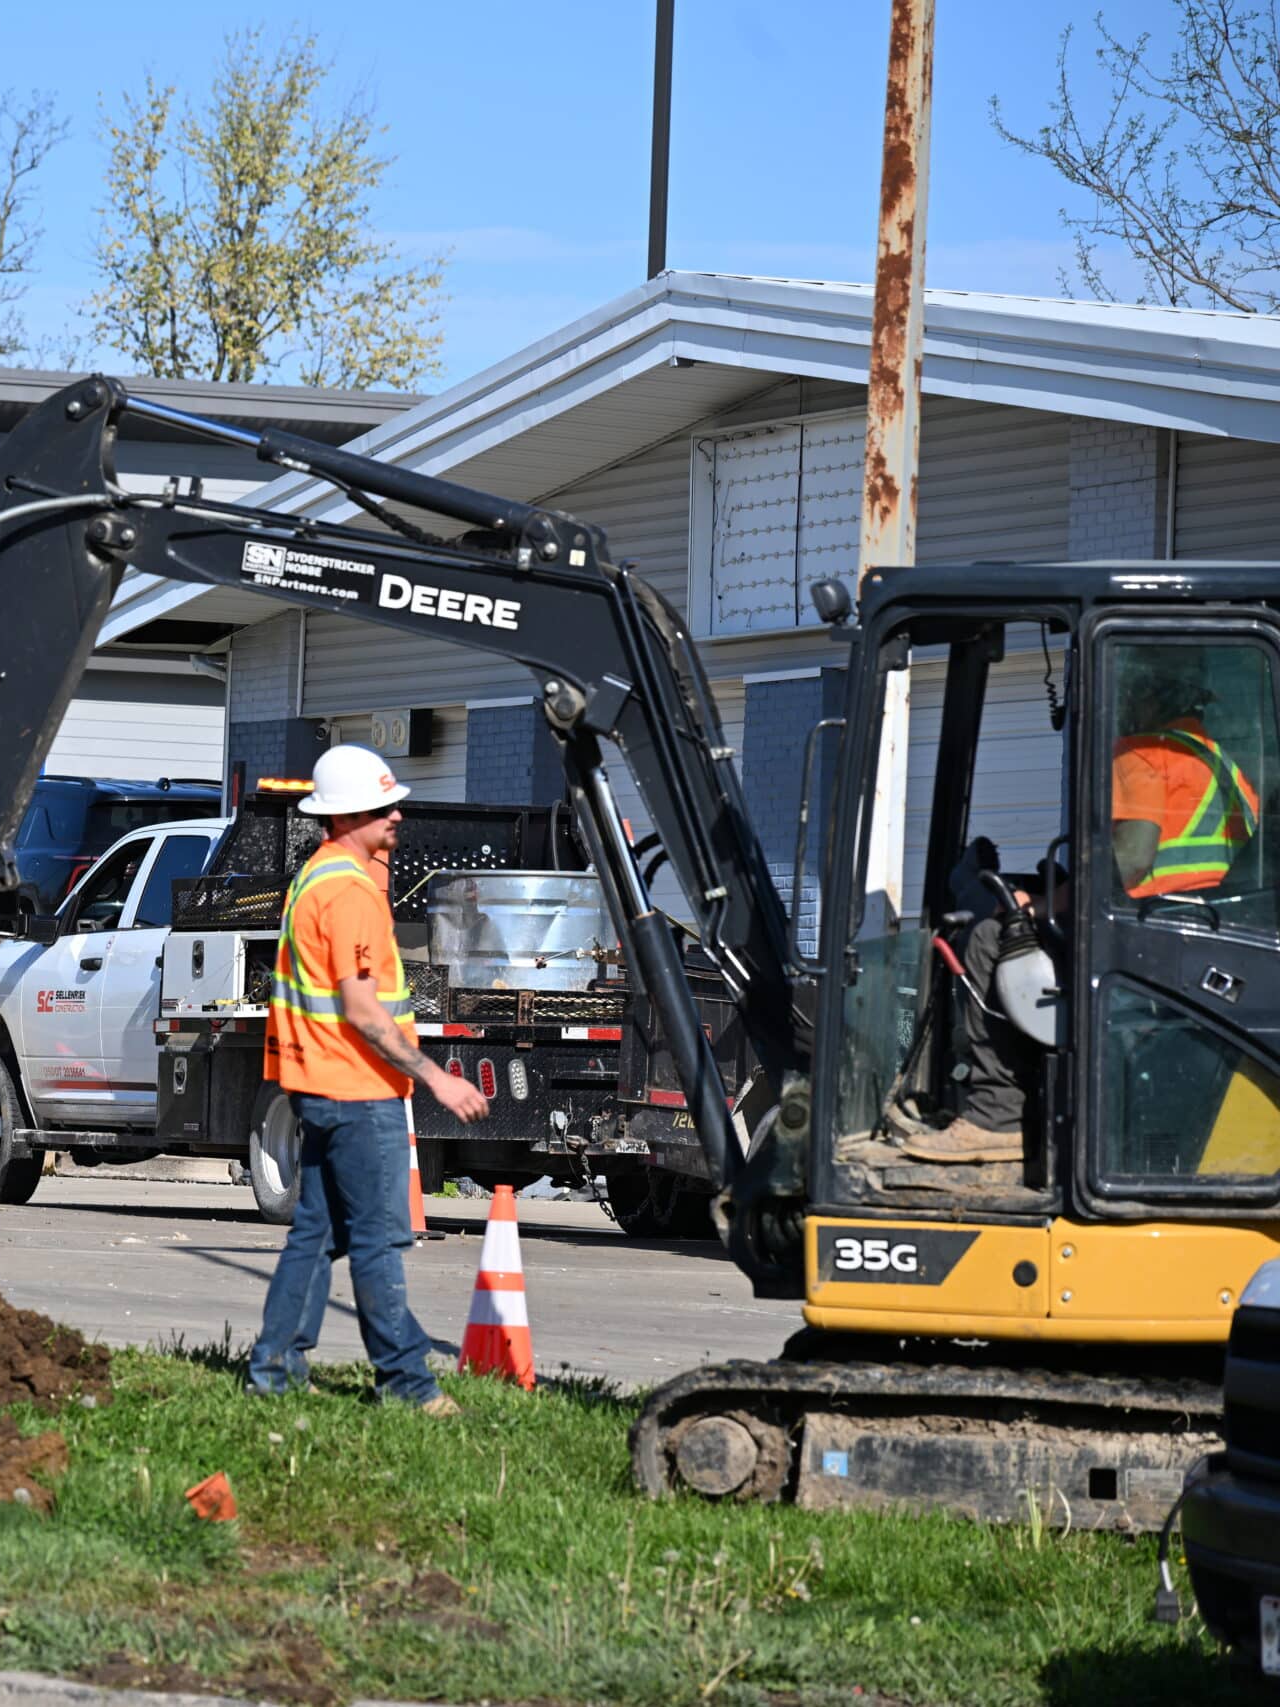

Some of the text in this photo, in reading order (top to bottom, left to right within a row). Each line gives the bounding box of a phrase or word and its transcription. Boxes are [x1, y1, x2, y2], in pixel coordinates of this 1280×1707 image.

[247, 544, 283, 567] SN
[286, 551, 376, 576] SYDENSTRICKER
[285, 562, 323, 577] NOBBE
[253, 573, 359, 600] SNPartners.com
[377, 573, 522, 630] DEERE
[834, 1237, 918, 1273] 35G
